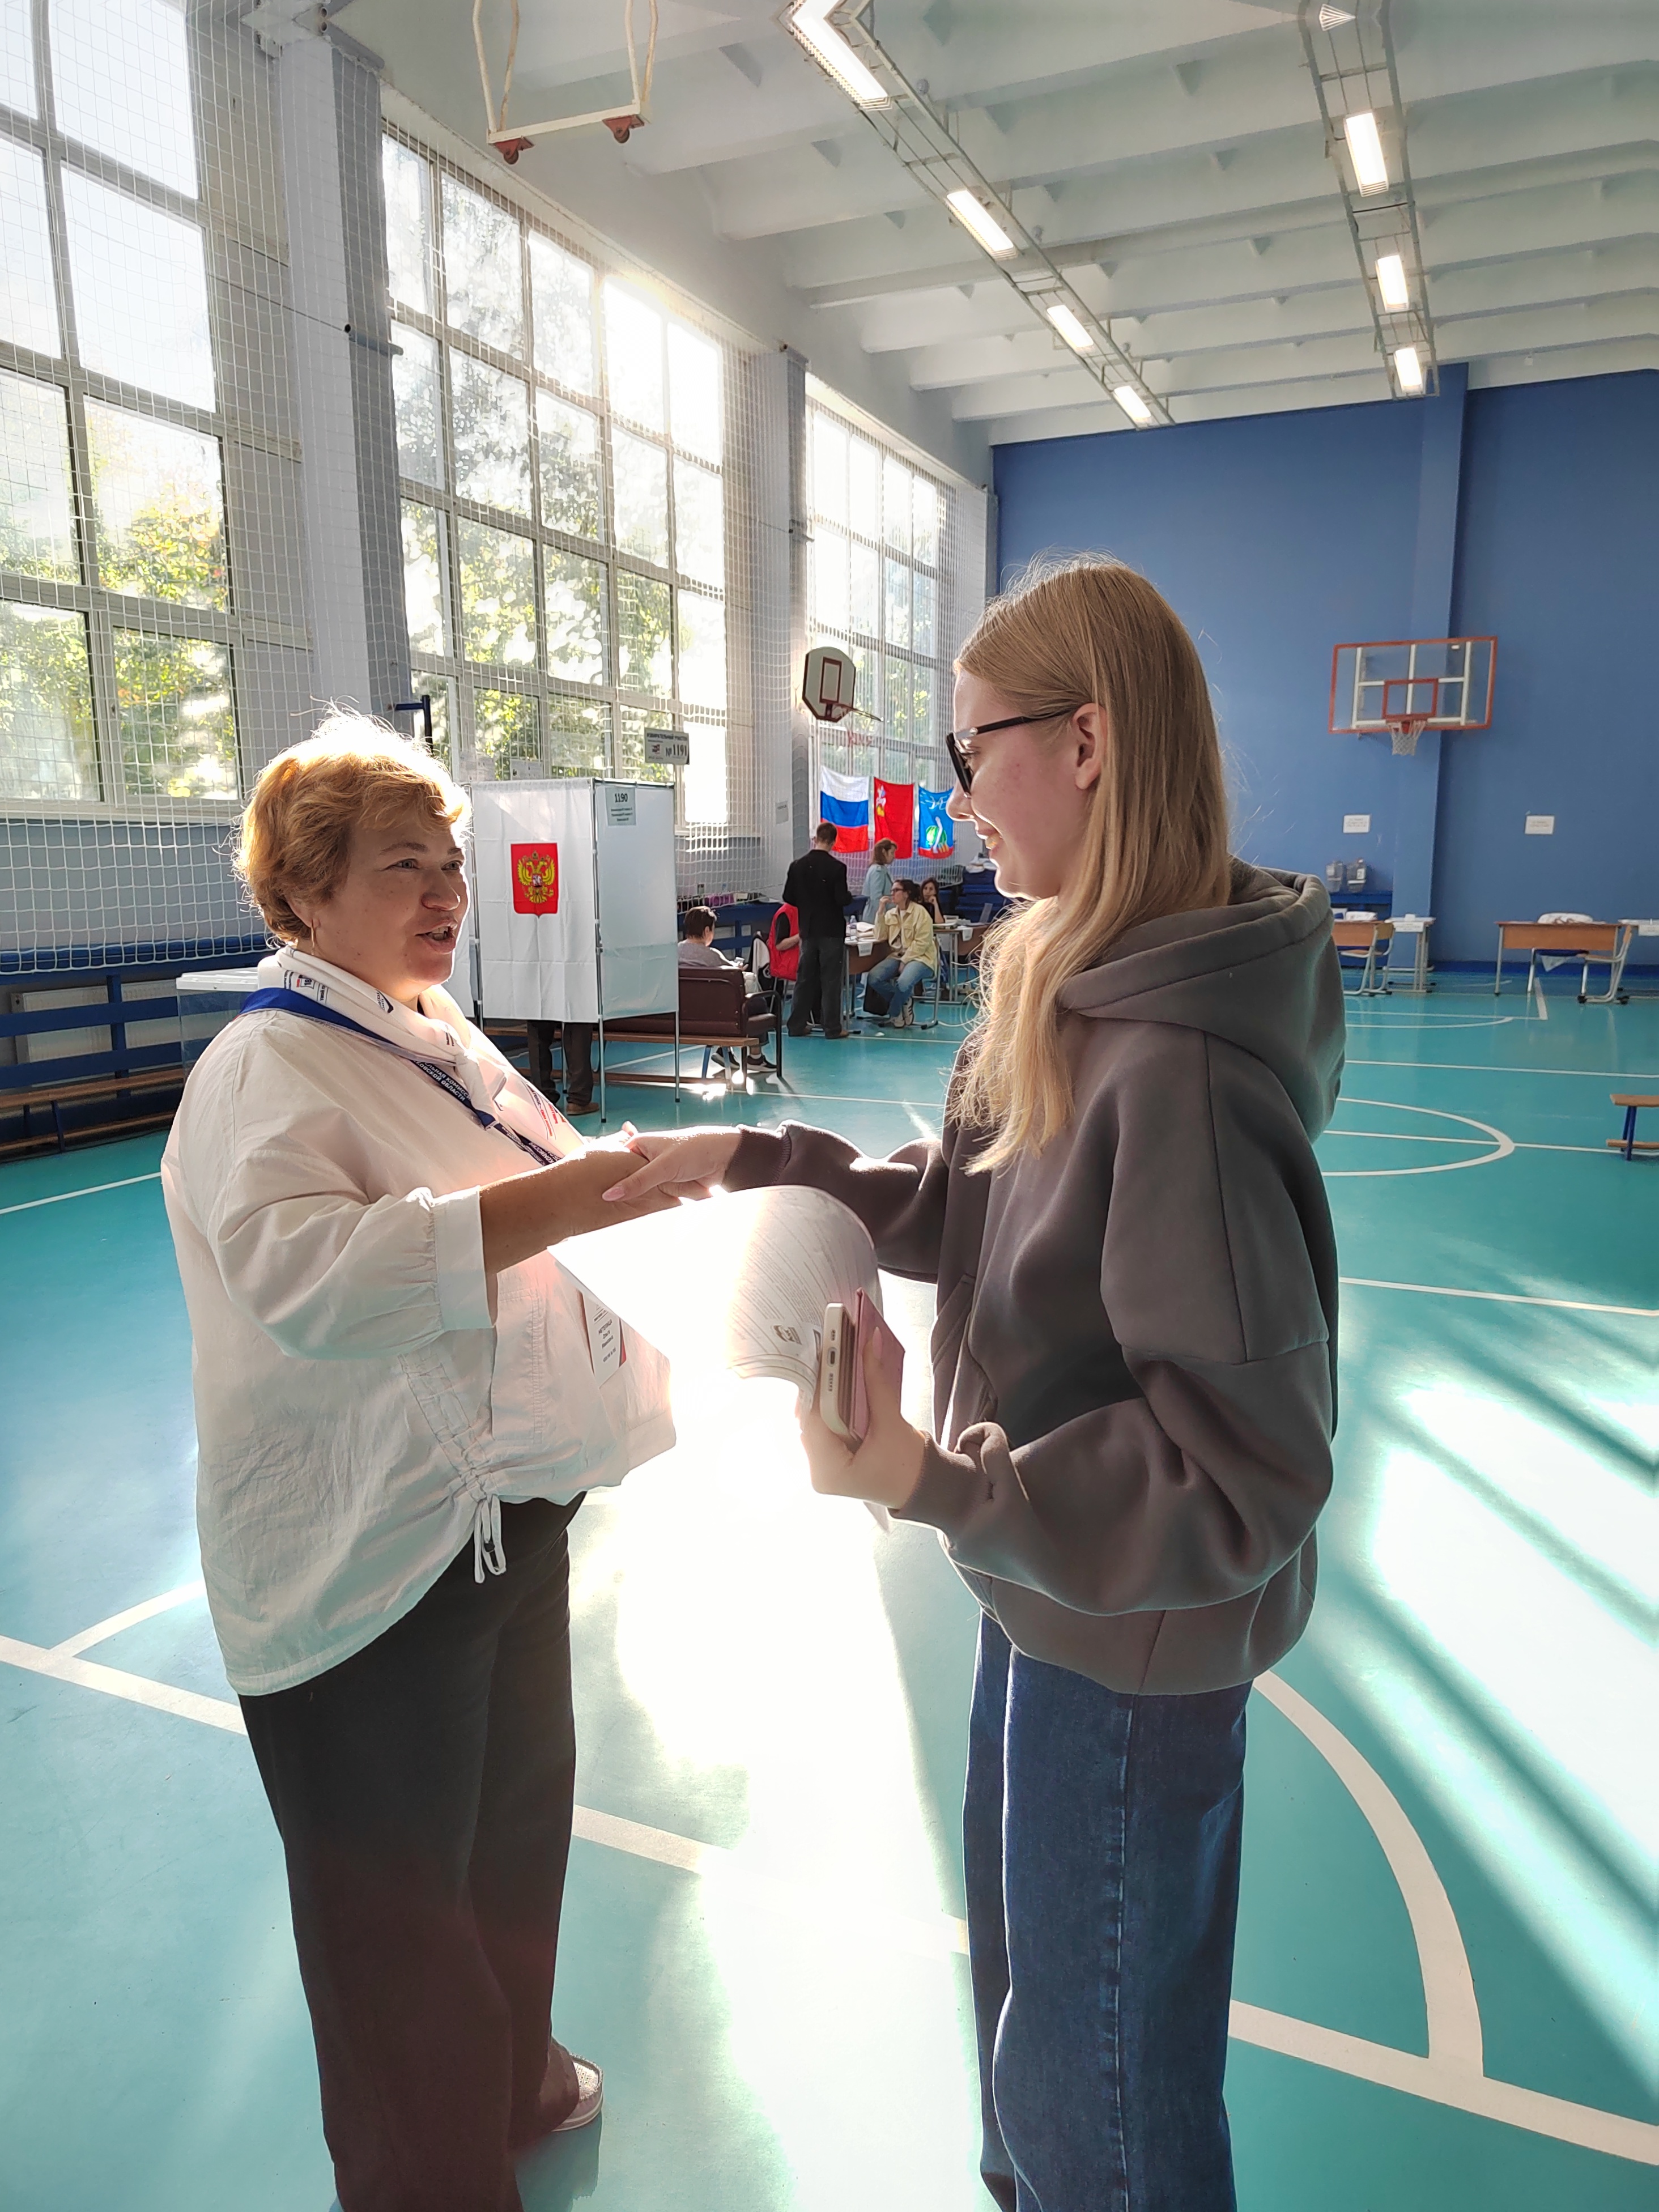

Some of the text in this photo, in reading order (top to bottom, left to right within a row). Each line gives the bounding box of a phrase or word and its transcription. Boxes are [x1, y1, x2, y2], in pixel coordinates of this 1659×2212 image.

[614, 793, 628, 803] 1190
[441, 1080, 466, 1101] ОБЛАСТИ
[445, 1077, 471, 1101] КОМИССИ
